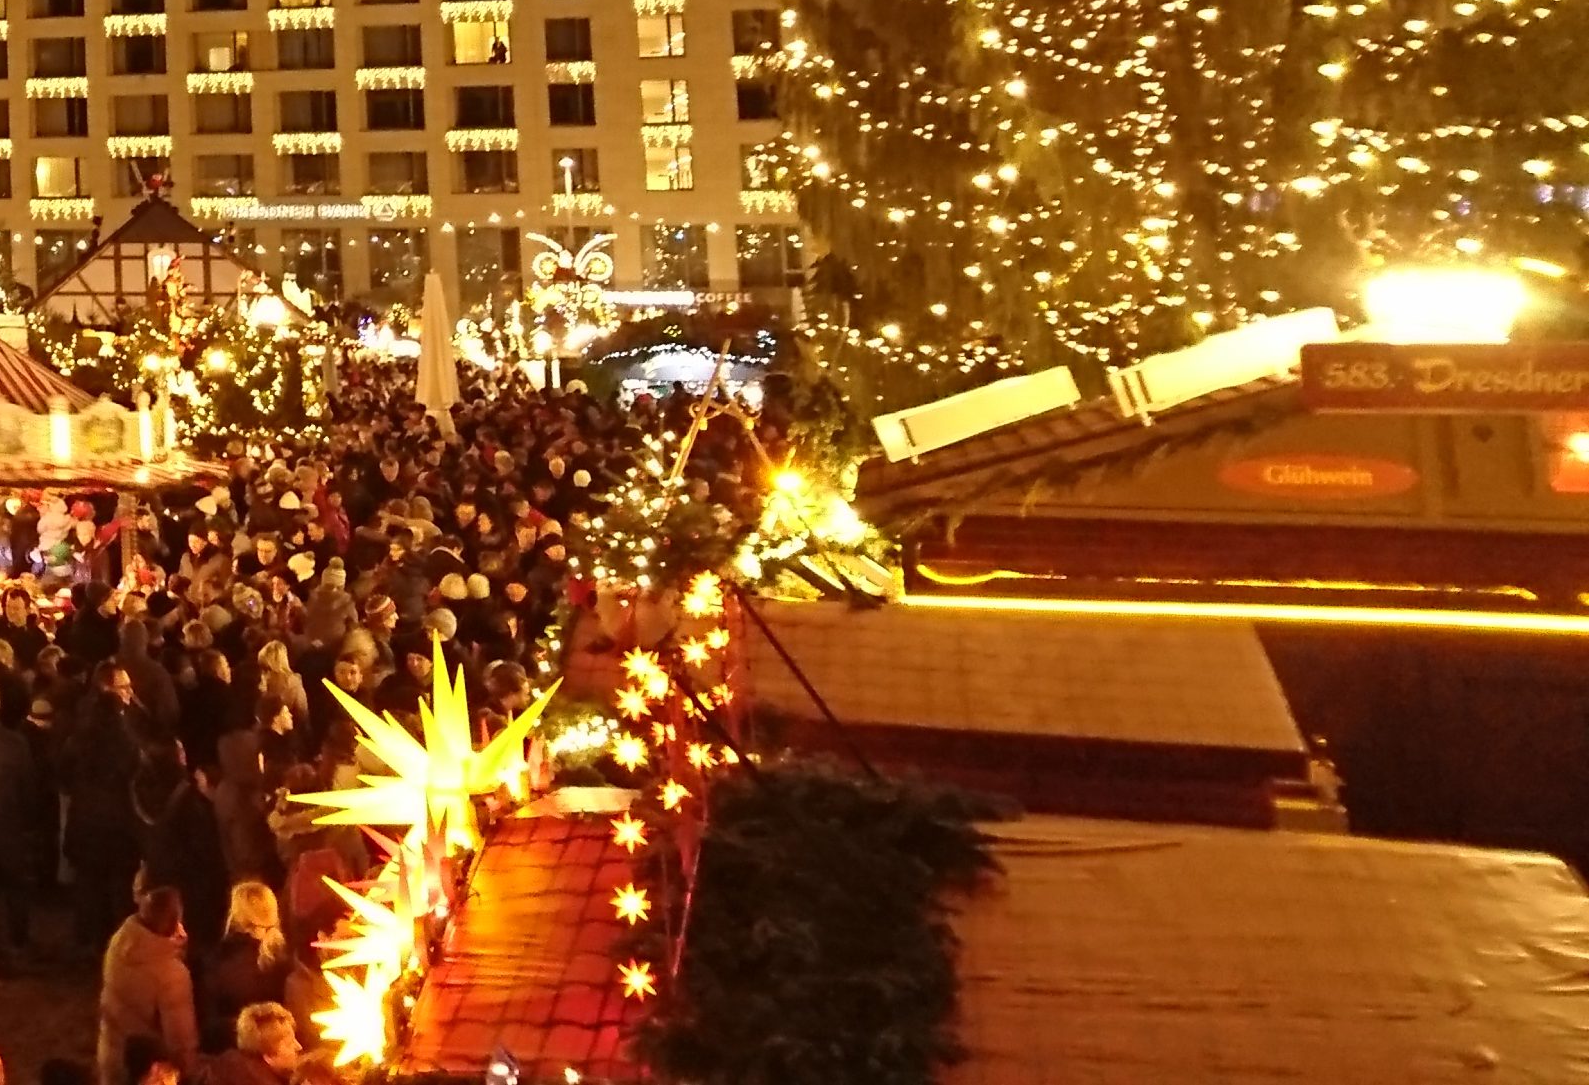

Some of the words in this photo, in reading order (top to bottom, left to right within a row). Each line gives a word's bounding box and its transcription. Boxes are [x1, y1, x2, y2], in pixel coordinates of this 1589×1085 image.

[695, 292, 753, 304] COFFEE
[1413, 356, 1589, 393] Dresdner
[1263, 463, 1374, 486] Glühwein
